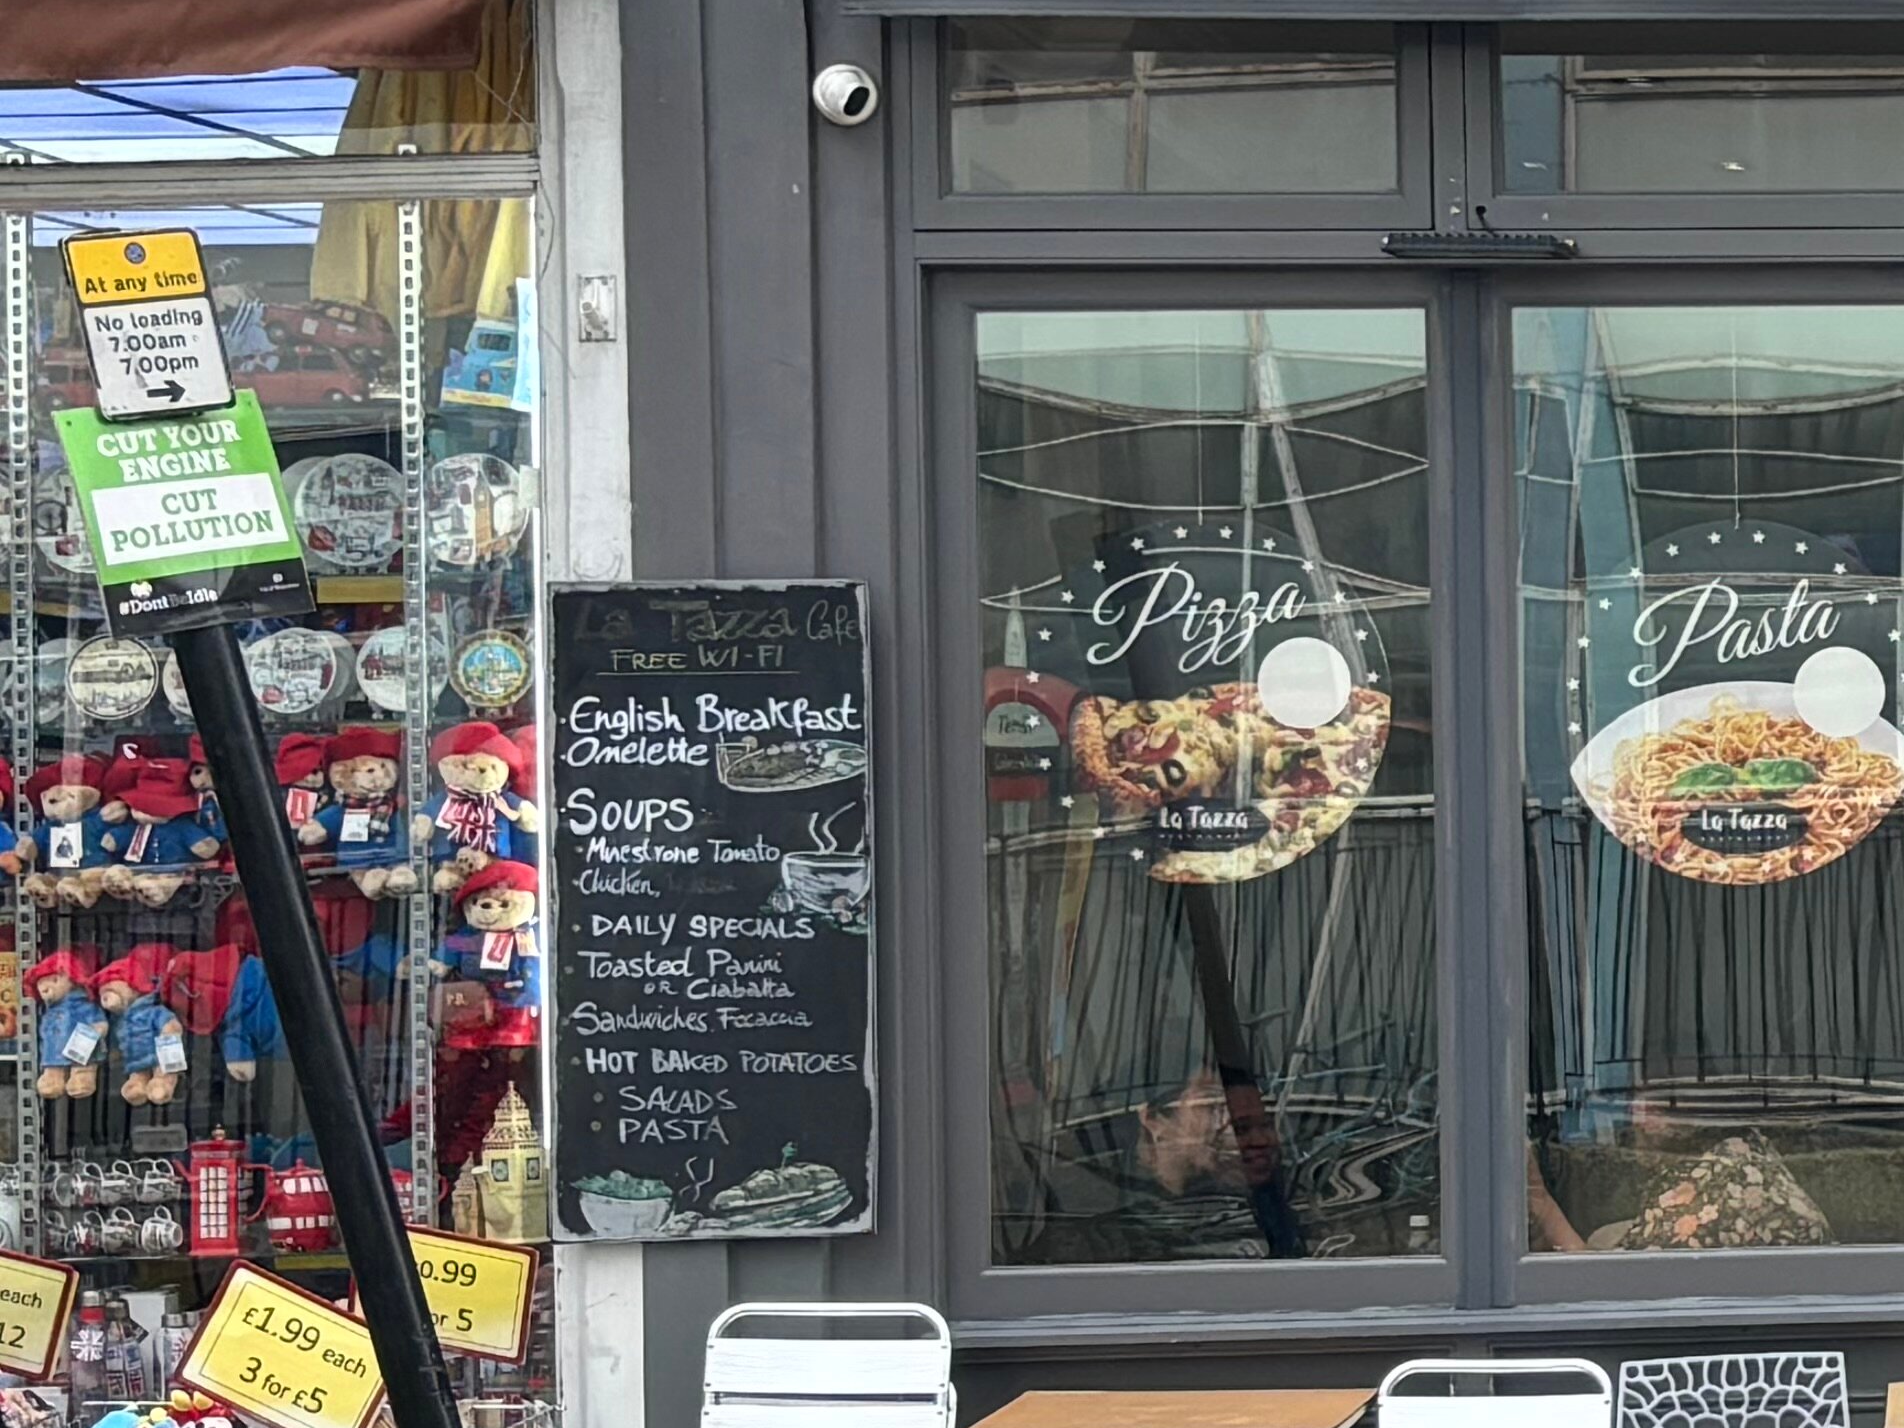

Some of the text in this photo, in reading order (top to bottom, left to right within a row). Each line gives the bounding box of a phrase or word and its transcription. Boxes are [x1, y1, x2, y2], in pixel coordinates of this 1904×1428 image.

[84, 271, 199, 295] At any time
[95, 308, 203, 332] No loading
[107, 334, 186, 352] 7.00am
[119, 355, 199, 376] 7.00pm
[96, 420, 241, 458] CUT YOUR
[118, 447, 231, 483] ENGINE
[161, 488, 217, 516] CUT
[110, 510, 275, 553] POLLUTION
[1086, 561, 1306, 673] Pizza
[1627, 576, 1841, 688] Pasta
[610, 648, 687, 671] FREE
[569, 695, 685, 740] English
[566, 737, 710, 767] Omelette
[1159, 805, 1249, 830] La Tazza
[1701, 807, 1788, 832] La Tazza
[707, 833, 781, 864] Tomato
[592, 913, 816, 946] DAILY SPECIALS
[577, 947, 783, 979] Toasted Panini
[585, 1048, 858, 1074] HOT BAKED POTATOES
[618, 1086, 739, 1112] SALADS
[618, 1115, 730, 1145] PASTA
[416, 1259, 478, 1288] 0.99
[0, 1288, 43, 1309] each
[432, 1308, 474, 1333] or 5
[241, 1306, 368, 1379] £1.99 each
[239, 1357, 329, 1415] 3 for £5
